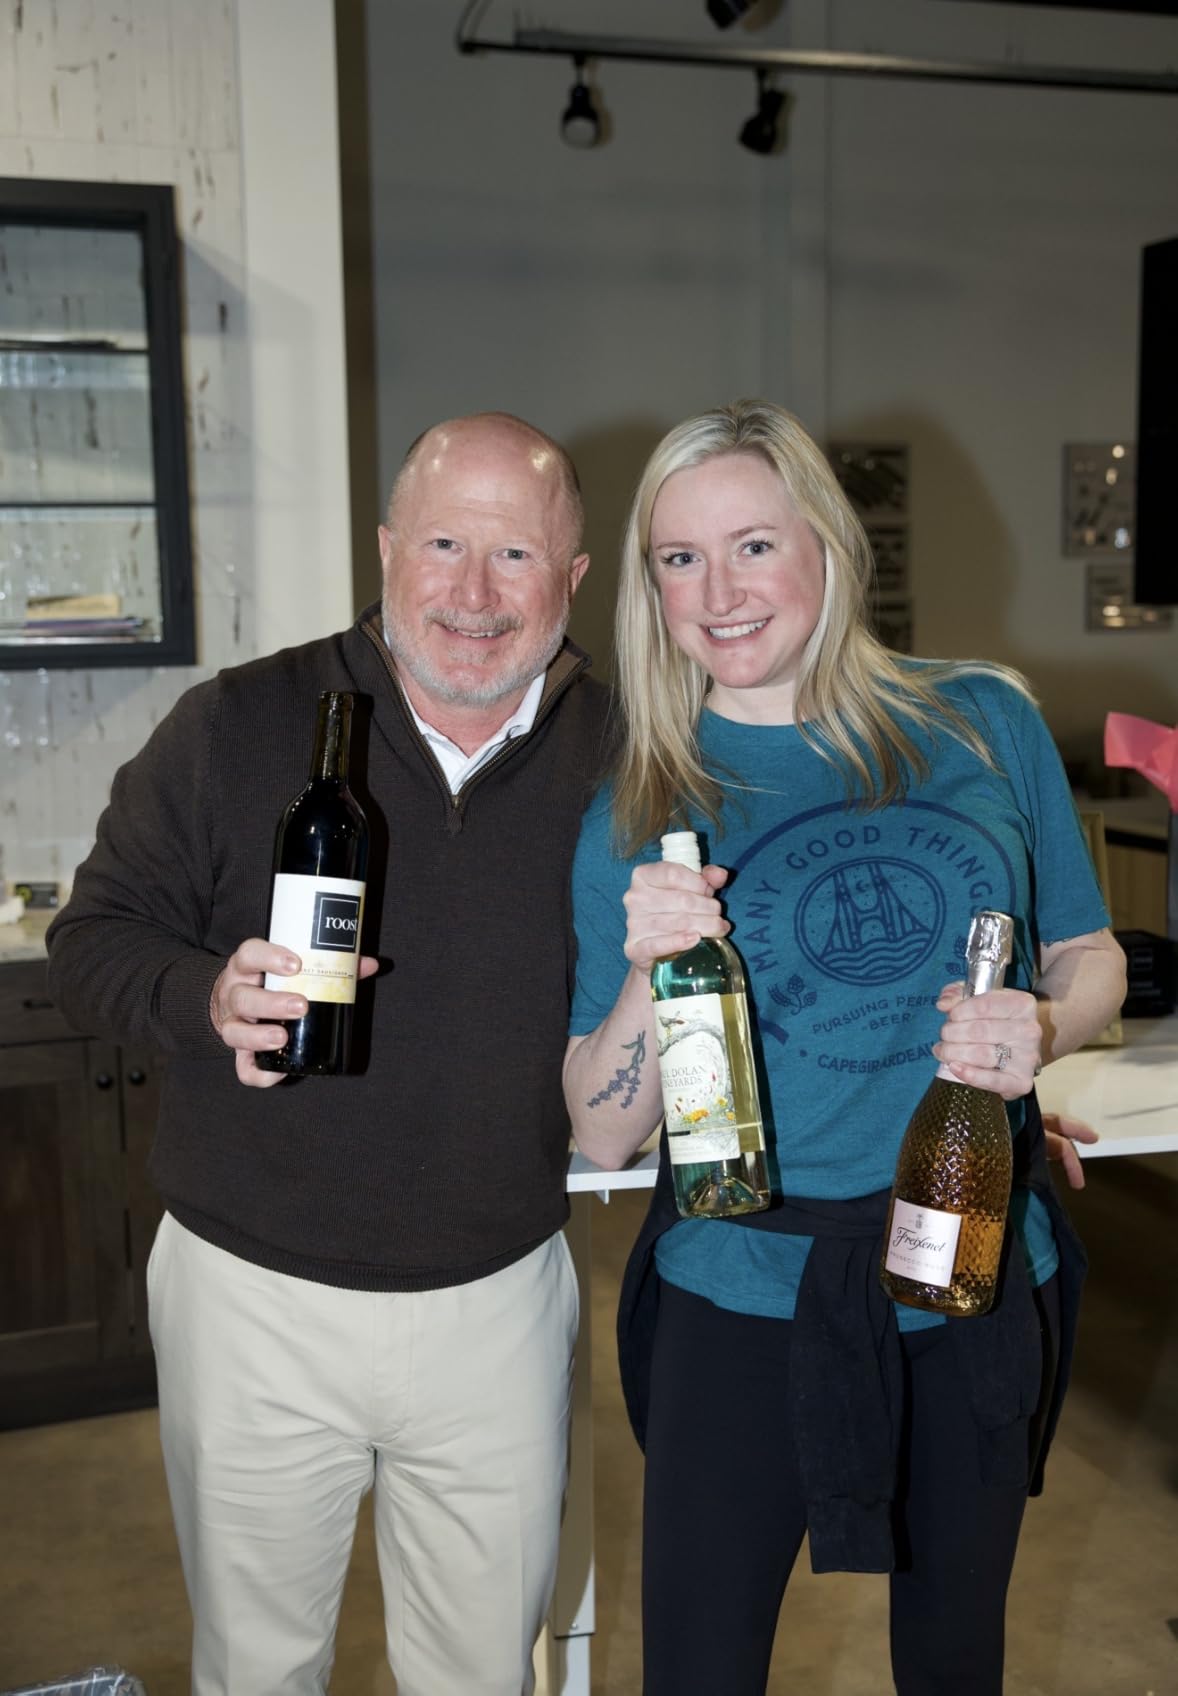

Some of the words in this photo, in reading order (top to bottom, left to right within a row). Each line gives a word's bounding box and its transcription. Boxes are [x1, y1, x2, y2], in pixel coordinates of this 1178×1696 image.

[744, 878, 781, 974] MANY
[786, 825, 882, 871] GOOD
[812, 998, 889, 1034] PURSUING
[896, 995, 940, 1008] PERFE
[892, 1226, 947, 1252] Freixenet
